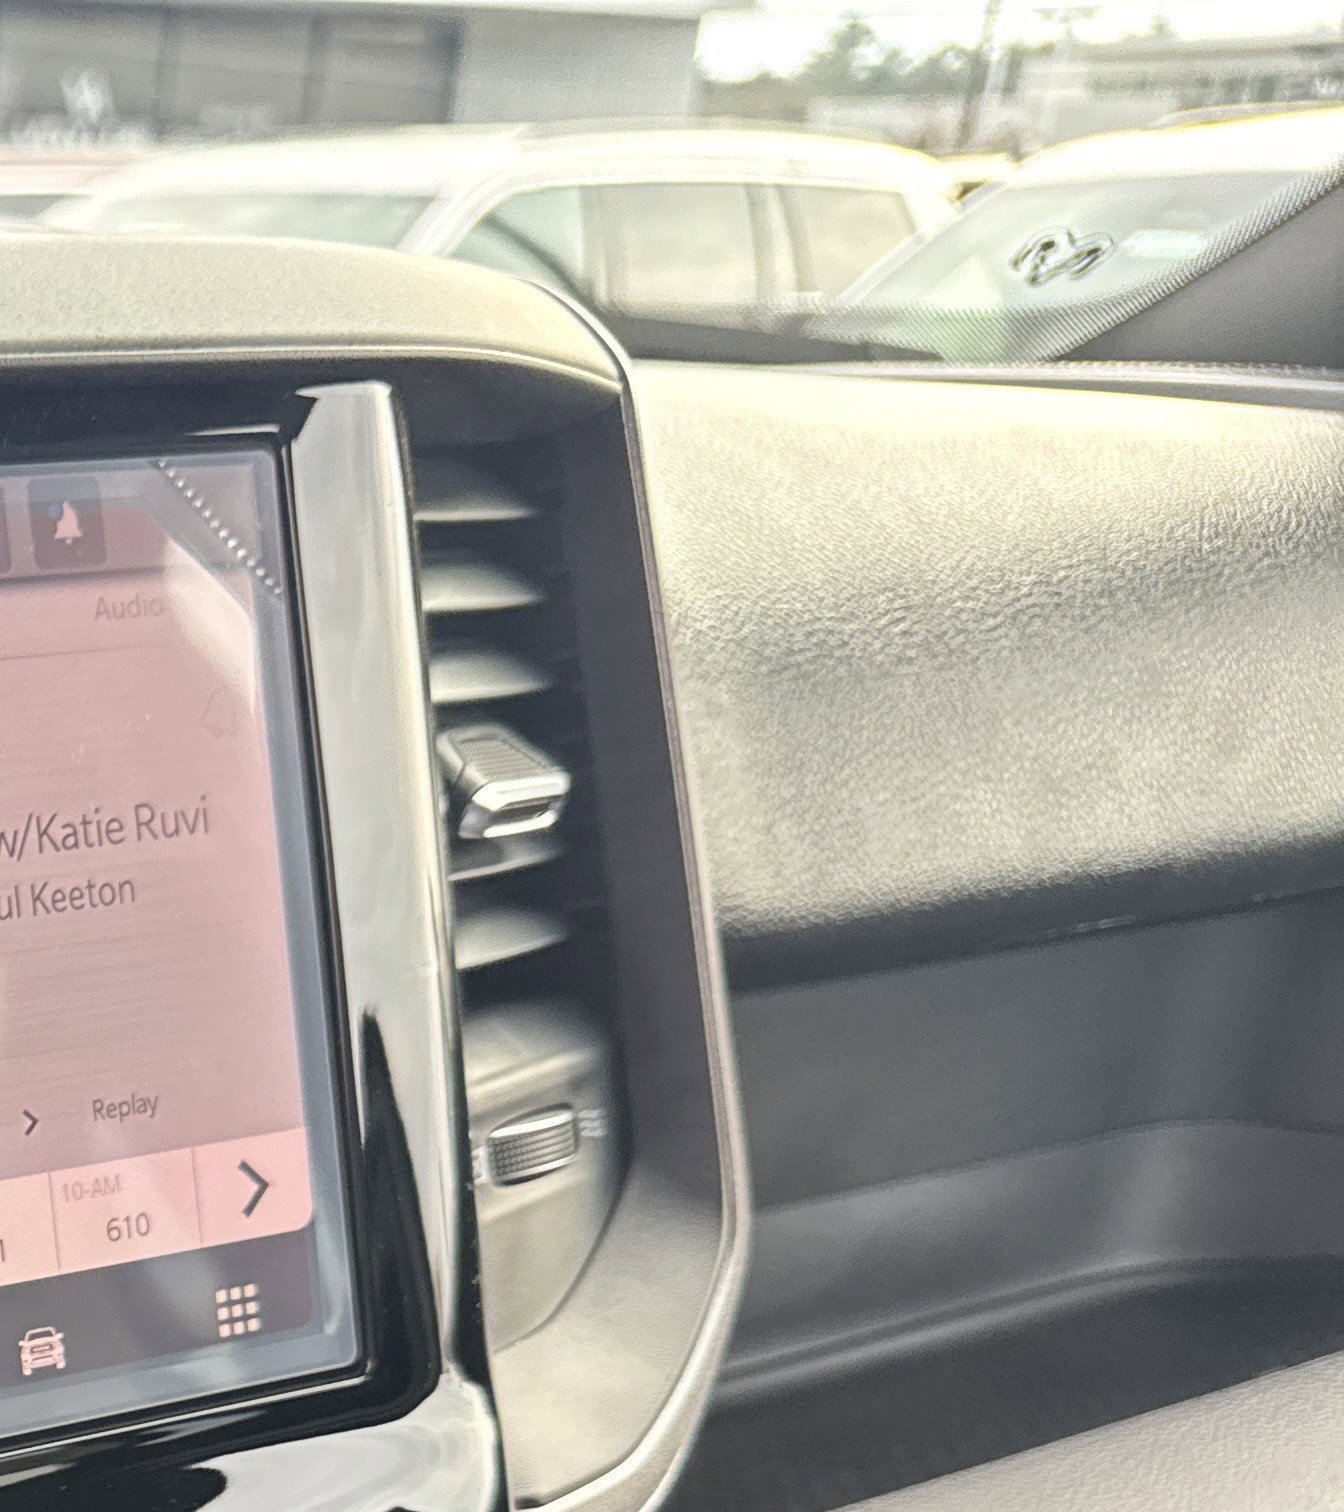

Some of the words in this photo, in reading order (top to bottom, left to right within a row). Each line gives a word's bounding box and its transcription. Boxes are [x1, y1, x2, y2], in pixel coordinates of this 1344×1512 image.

[94, 595, 165, 623] Audio
[135, 796, 211, 841] Ruvi
[31, 877, 135, 915] Keeton
[92, 1092, 159, 1122] Replay
[62, 1174, 121, 1202] 10-AM
[107, 1213, 150, 1242] 610
